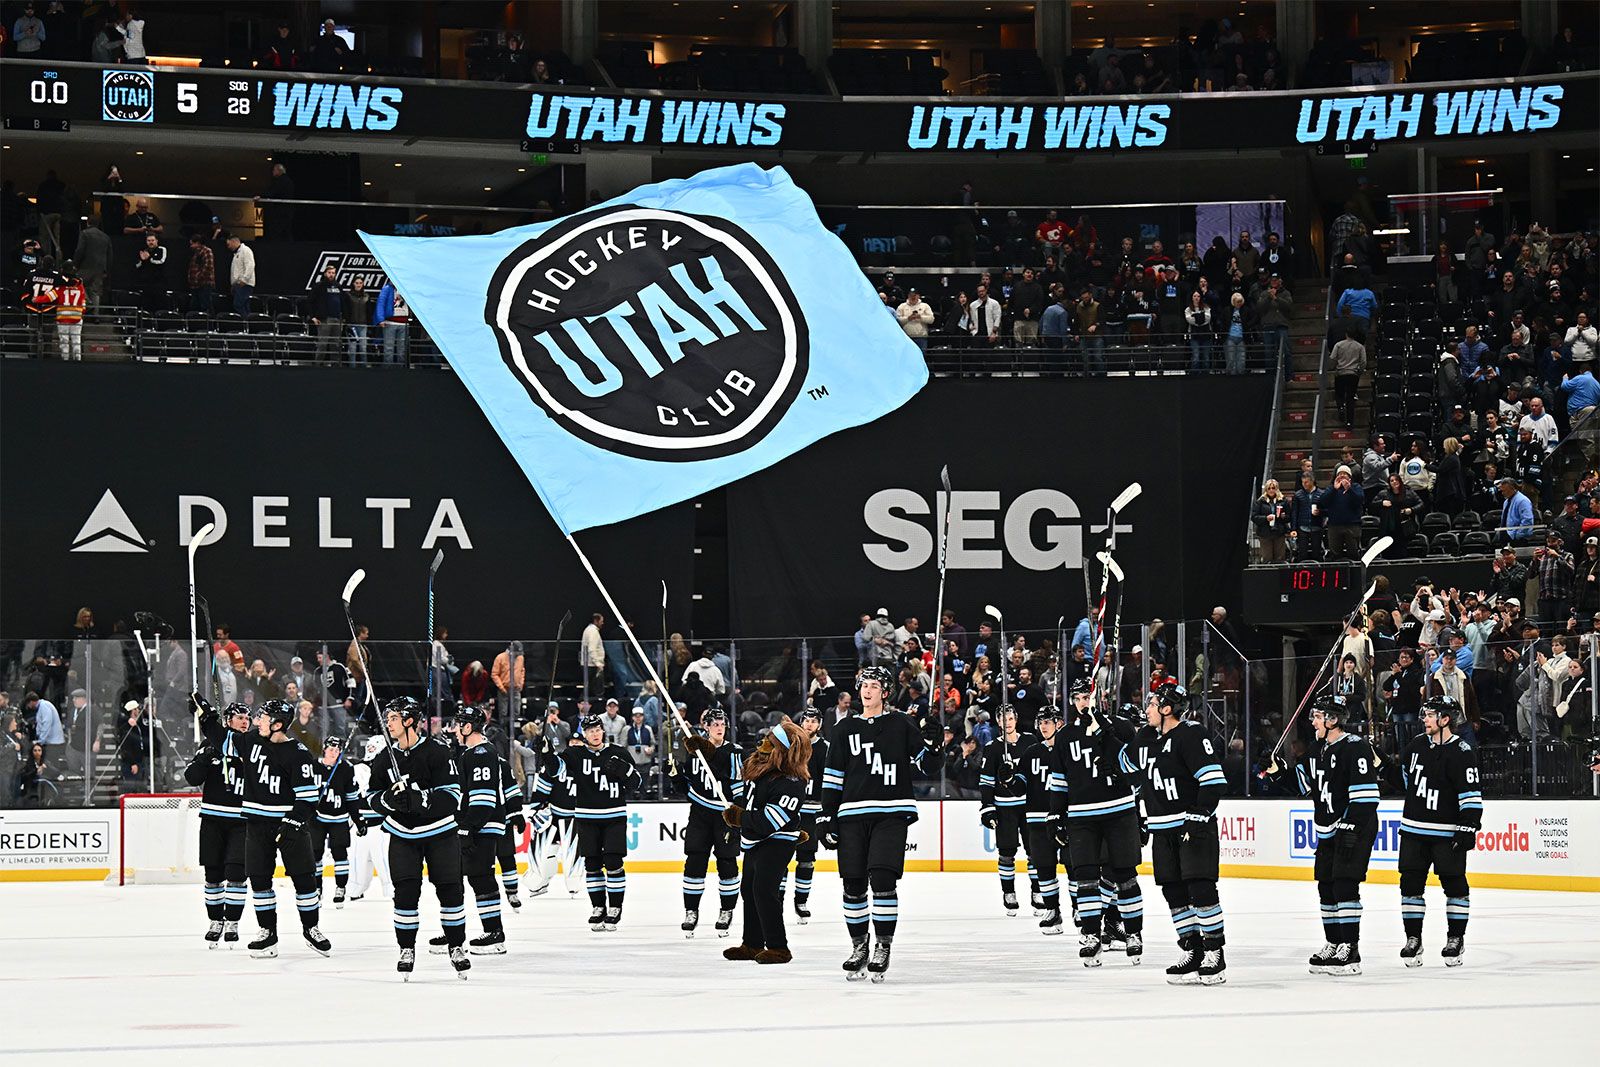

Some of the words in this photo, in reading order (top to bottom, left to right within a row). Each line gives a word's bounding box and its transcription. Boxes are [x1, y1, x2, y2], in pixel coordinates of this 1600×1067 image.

[43, 71, 58, 79] 3RD
[112, 73, 146, 86] HOCKEY
[31, 80, 68, 105] 0.0
[229, 81, 249, 91] SOG
[108, 87, 149, 108] UTAH
[177, 83, 198, 113] 5
[227, 97, 250, 114] 28
[273, 81, 403, 130] WINS
[117, 110, 140, 119] CLUB
[526, 94, 651, 143] UTAH
[661, 100, 786, 145] WINS
[1296, 93, 1424, 143] UTAH
[1433, 85, 1564, 136] WINS
[34, 120, 40, 129] B
[62, 121, 68, 130] 2
[907, 105, 1034, 149] UTAH
[1044, 104, 1171, 149] WINS
[522, 141, 528, 150] 2
[548, 143, 554, 151] C
[573, 144, 579, 152] 3
[1318, 145, 1324, 154] 3
[347, 256, 363, 266] FOR
[527, 226, 683, 313] HOCKEY
[63, 289, 81, 306] 17
[532, 255, 768, 398] UTAH
[656, 369, 757, 427] CLUB
[807, 385, 829, 402] TM
[178, 494, 474, 550] DELTA
[1293, 570, 1339, 590] 10:11
[1162, 738, 1172, 753] A
[1202, 738, 1214, 755] 8
[250, 743, 281, 795] UTAH
[849, 734, 897, 786] UTAH
[1330, 754, 1337, 769] C
[1358, 757, 1368, 775] 9
[473, 766, 491, 781] 28
[582, 758, 620, 798] UTAH
[1139, 746, 1179, 801] UTAH
[1409, 752, 1439, 811] UTAH
[558, 770, 577, 797] UTA
[1309, 757, 1335, 814] UTAH
[778, 795, 799, 811] 00
[1217, 817, 1256, 841] ALTH
[1539, 817, 1569, 826] INSURANCE
[0, 832, 102, 850] REDIENTS
[1293, 819, 1319, 850] BU
[1472, 823, 1530, 852] cordia
[1539, 829, 1569, 837] SOLUTIONS
[1241, 847, 1256, 857] UTAH
[1543, 840, 1550, 848] TO
[1551, 840, 1569, 848] REACH
[1535, 851, 1549, 859] YOUR
